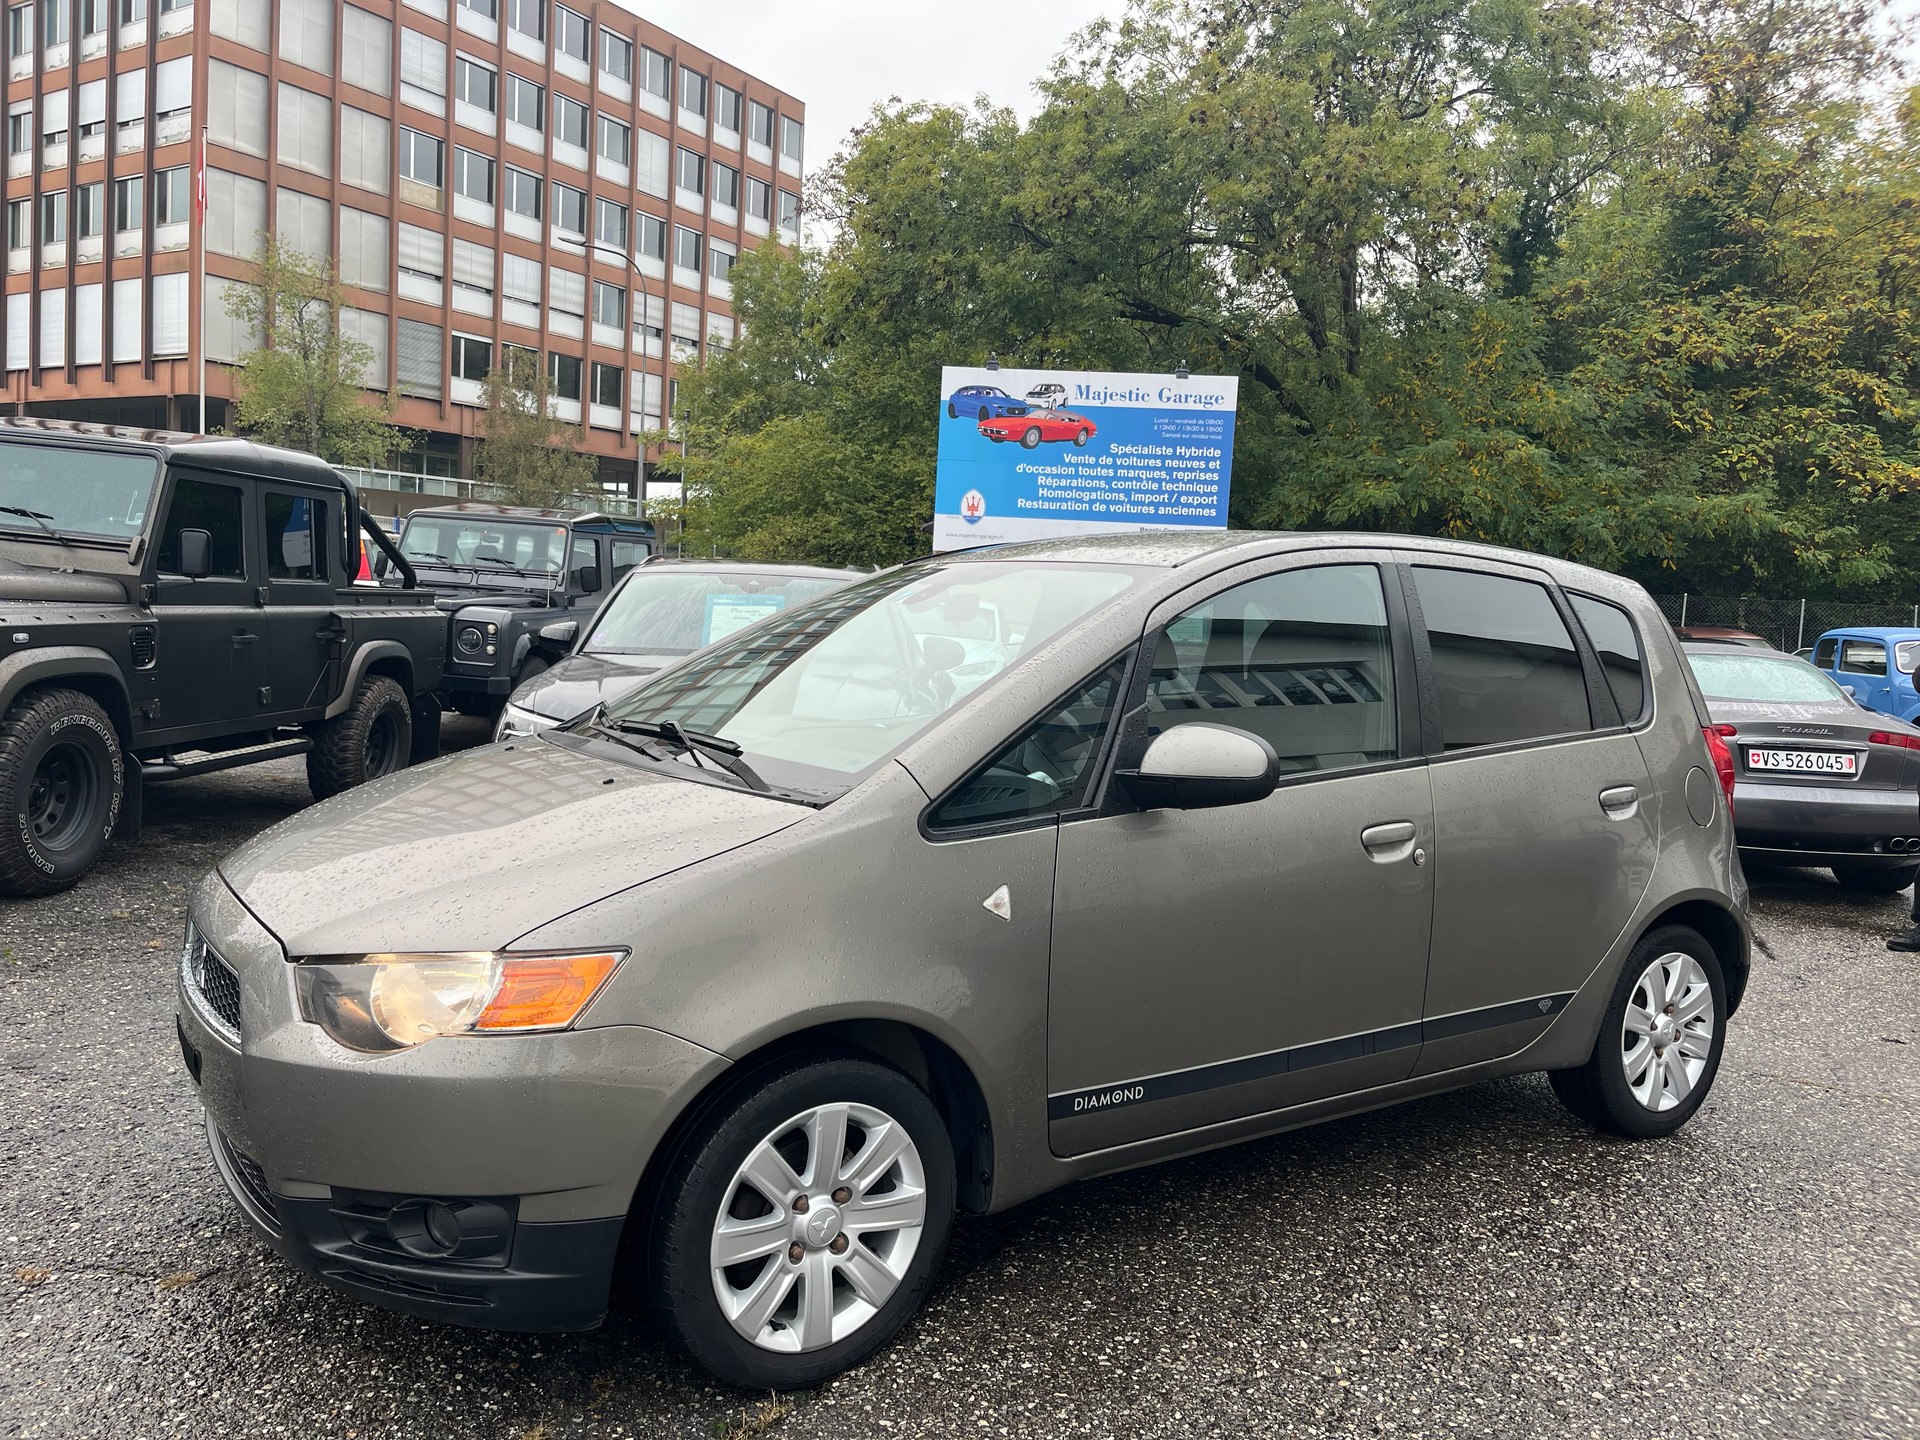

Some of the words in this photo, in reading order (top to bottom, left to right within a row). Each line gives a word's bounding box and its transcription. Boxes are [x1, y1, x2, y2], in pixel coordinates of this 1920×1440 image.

[1075, 384, 1150, 405] Majestic
[1158, 387, 1225, 408] Garage
[1110, 443, 1173, 456] Spécialiste
[1176, 446, 1221, 458] Hybride
[1063, 453, 1096, 464] Vente
[1099, 455, 1113, 465] de
[1116, 456, 1162, 467] voitures
[1165, 459, 1206, 468] neuves
[1209, 460, 1221, 469] et
[1078, 466, 1114, 476] toutes
[1117, 468, 1170, 480] marques,
[1173, 470, 1219, 481] reprises
[1037, 475, 1109, 490] Réparations,
[1112, 479, 1159, 490] contrôle
[1162, 481, 1218, 494] technique
[1038, 488, 1128, 502] Homologations,
[1131, 491, 1169, 503] import
[1171, 493, 1178, 503] /
[1180, 495, 1218, 506] export
[1017, 498, 1089, 511] Restauration
[1092, 502, 1107, 511] de
[1109, 503, 1155, 513] voitures
[1158, 506, 1217, 517] anciennes
[50, 714, 116, 753] RENEGADE
[103, 792, 120, 840] M/T
[18, 813, 55, 874] RADAR
[1074, 1086, 1144, 1111] DIAMOND
